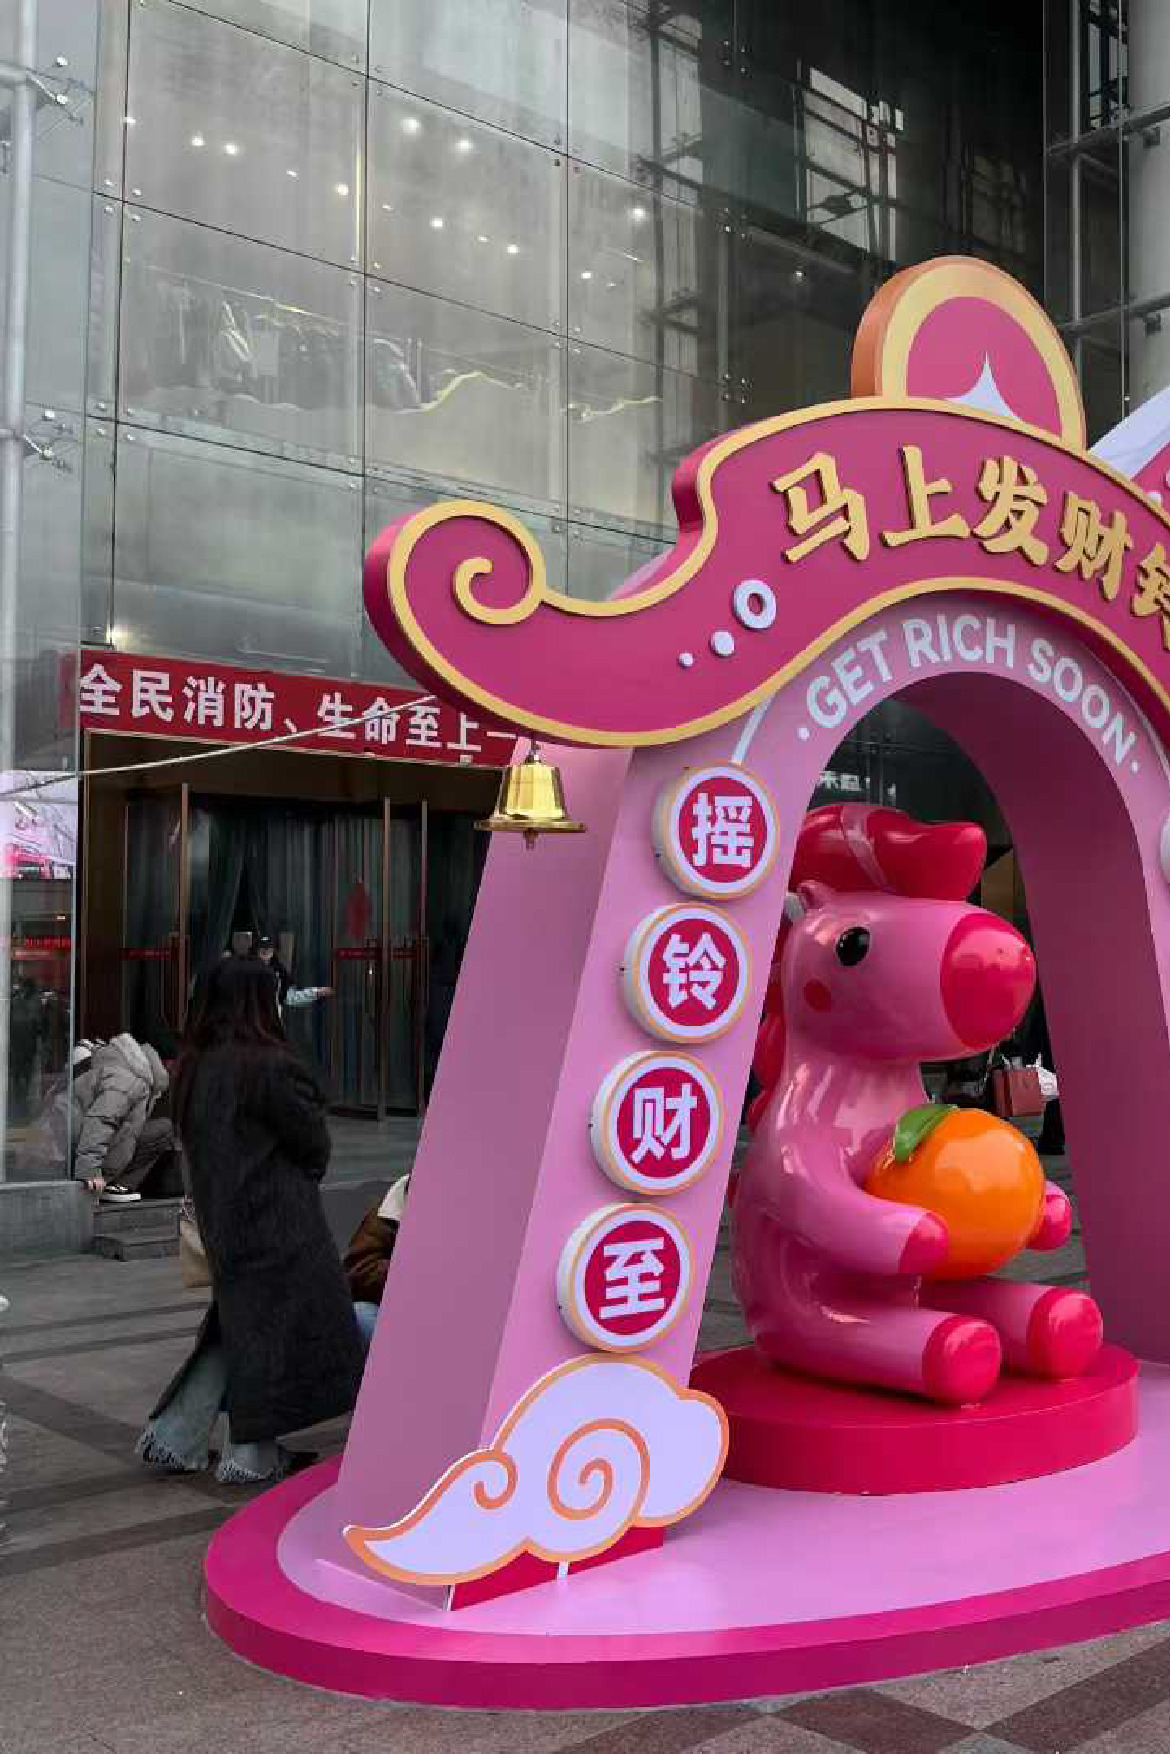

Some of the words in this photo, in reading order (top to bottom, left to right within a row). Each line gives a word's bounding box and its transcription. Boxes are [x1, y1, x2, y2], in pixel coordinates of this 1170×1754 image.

[806, 631, 893, 729] GET
[903, 614, 1016, 668] RICH
[1027, 637, 1136, 765] SOON
